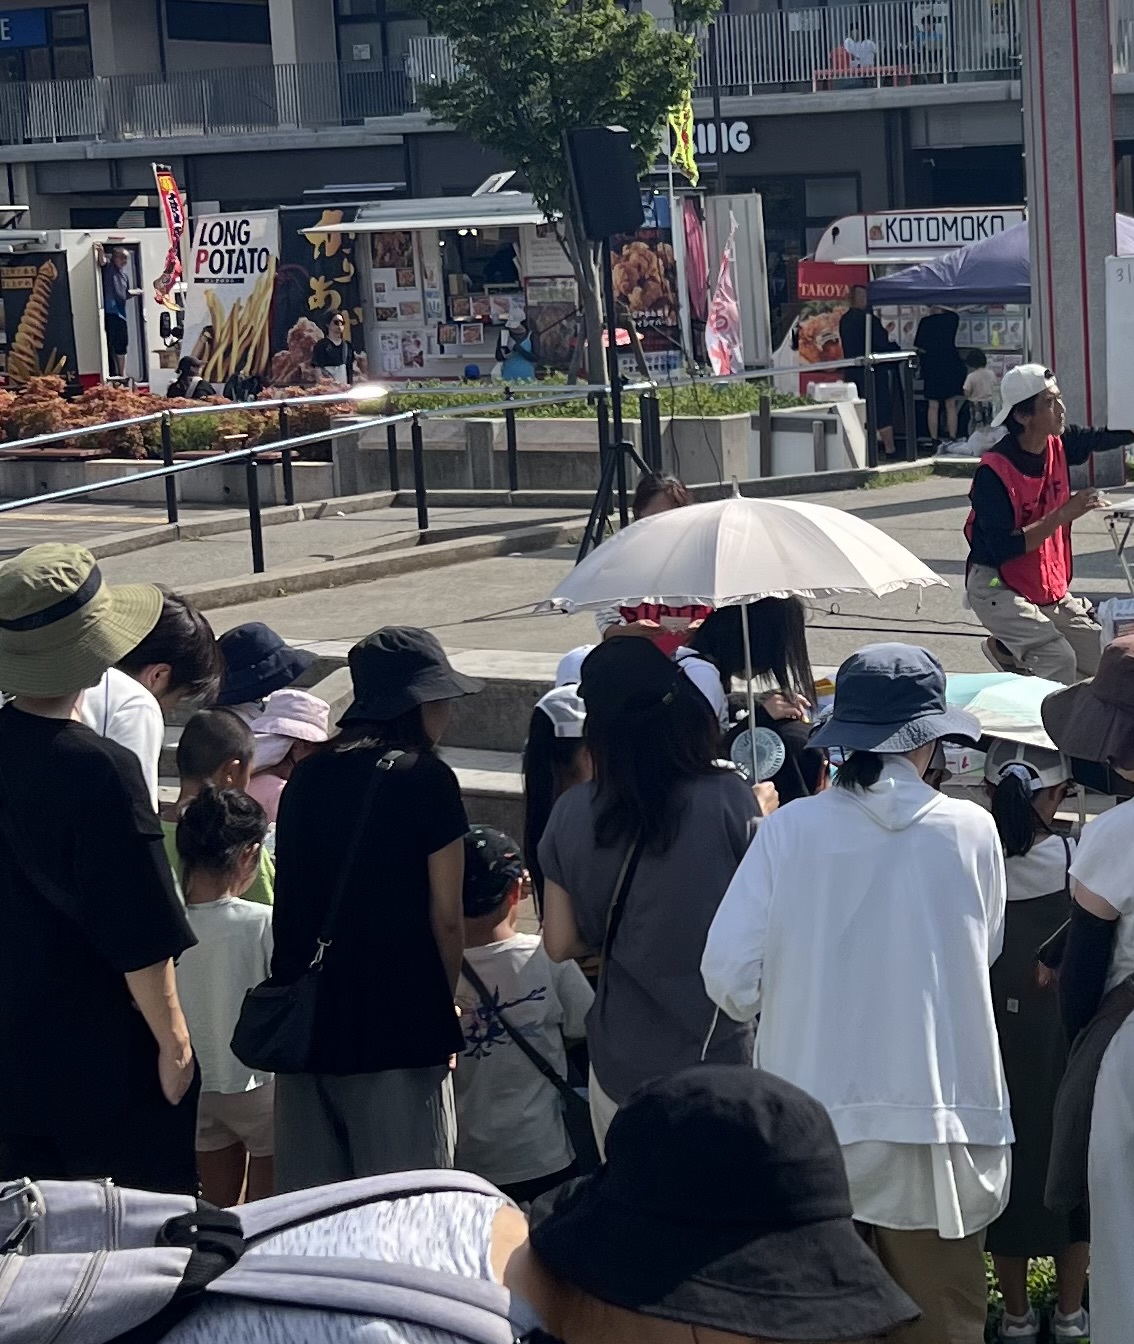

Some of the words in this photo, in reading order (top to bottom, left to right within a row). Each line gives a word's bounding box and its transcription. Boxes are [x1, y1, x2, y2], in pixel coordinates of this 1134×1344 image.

[198, 219, 251, 247] LONG
[195, 247, 270, 275] POTATO
[799, 283, 850, 297] TAKOYA
